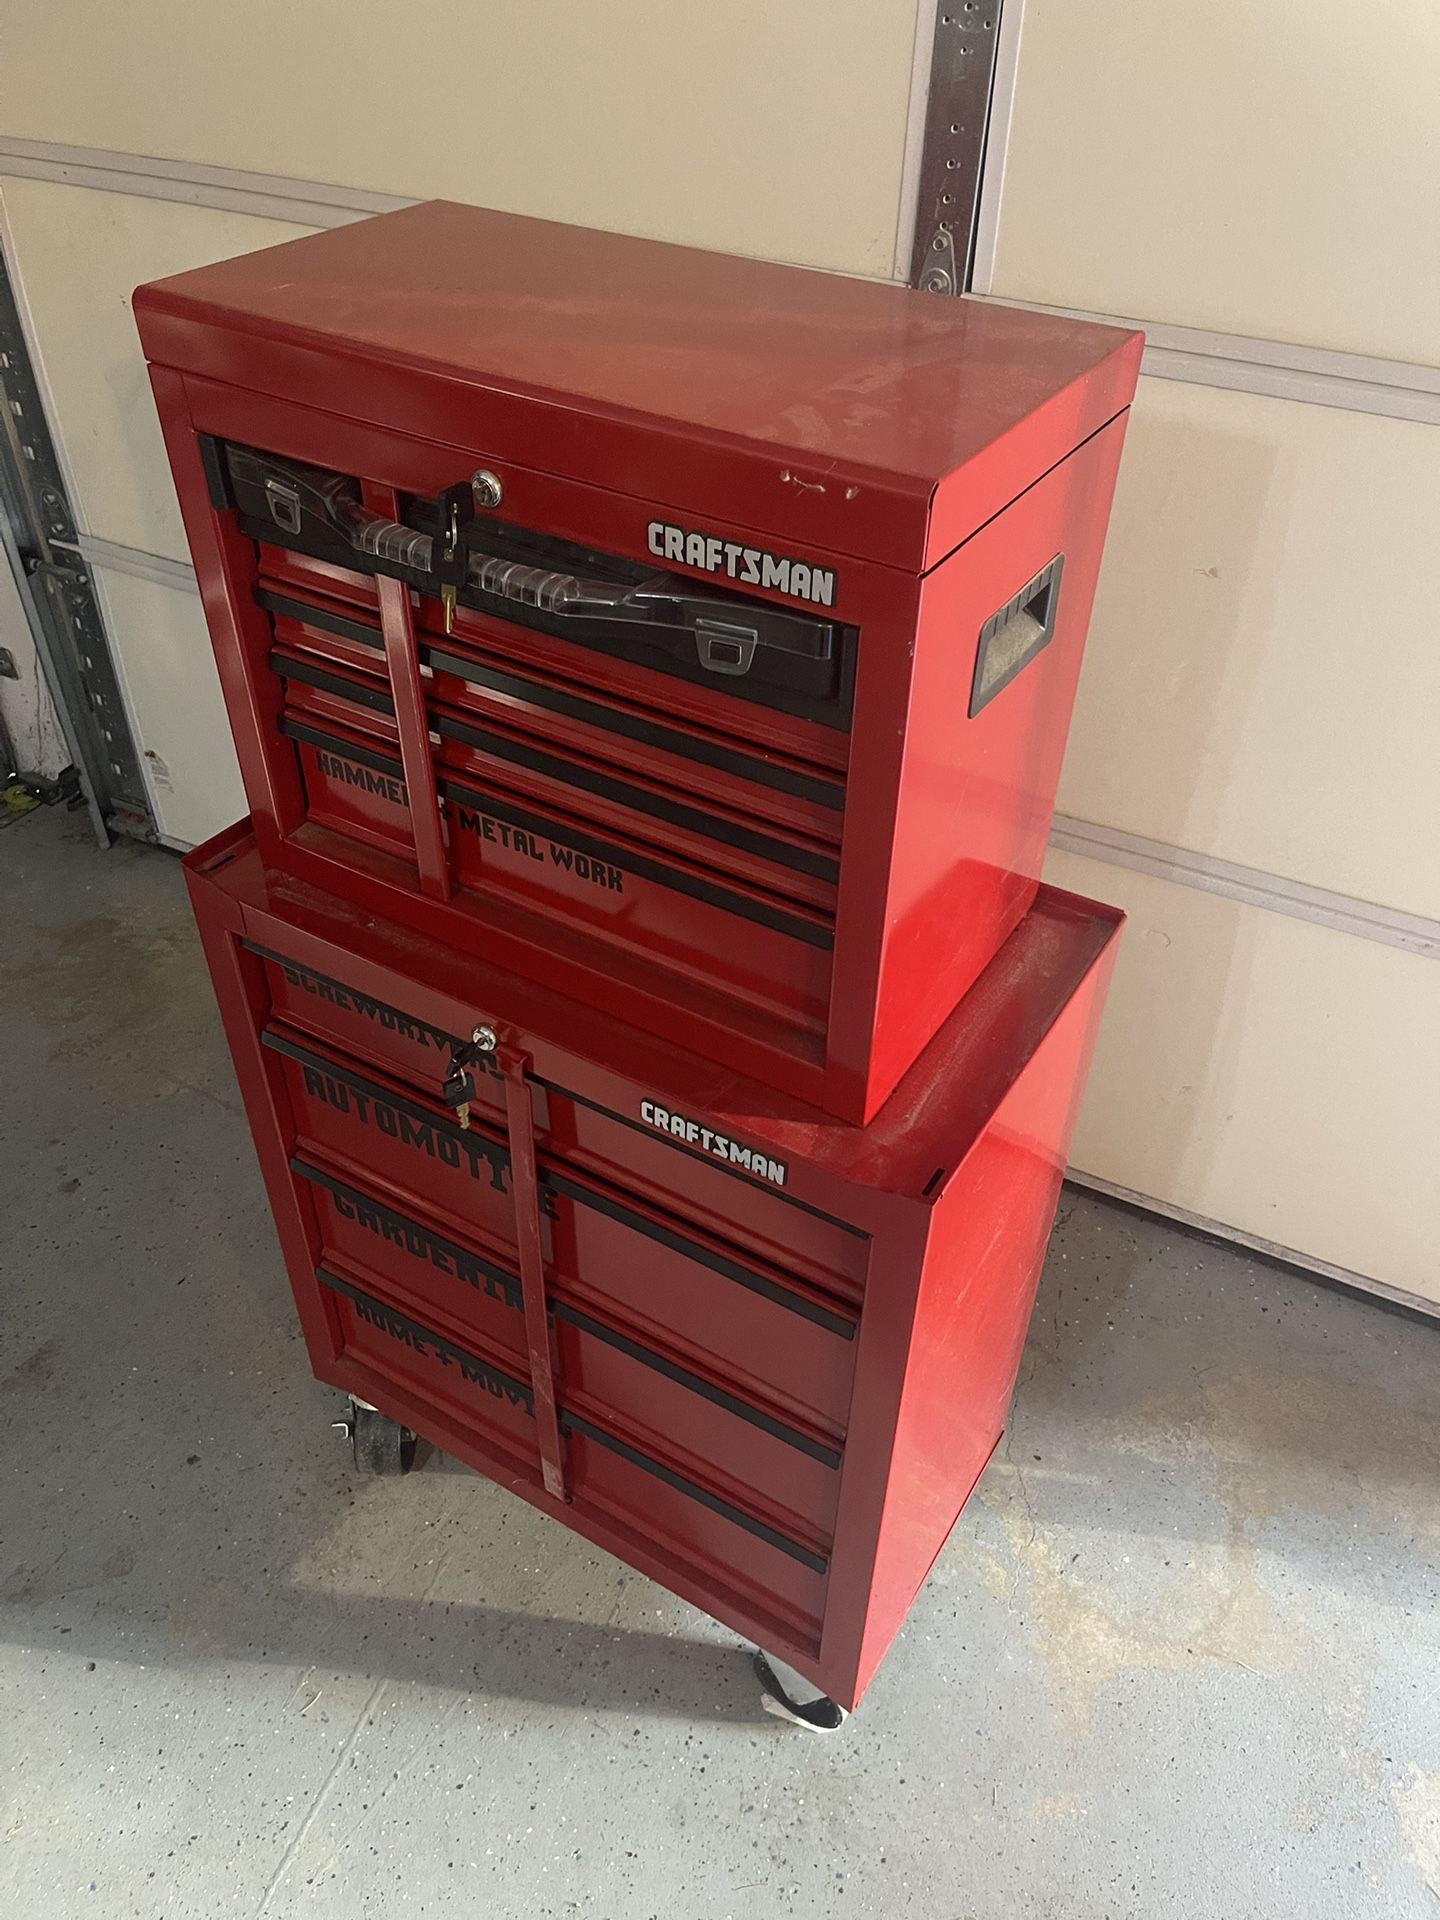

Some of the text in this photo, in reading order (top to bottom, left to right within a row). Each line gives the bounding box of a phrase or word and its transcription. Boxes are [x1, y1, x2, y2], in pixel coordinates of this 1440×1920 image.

[646, 520, 836, 608] CRAFTSMAN
[460, 808, 544, 861] METAL
[550, 846, 624, 893] WORK
[303, 1065, 560, 1222] AUTOMOTIE
[640, 1100, 787, 1186] CRAFTSMAN
